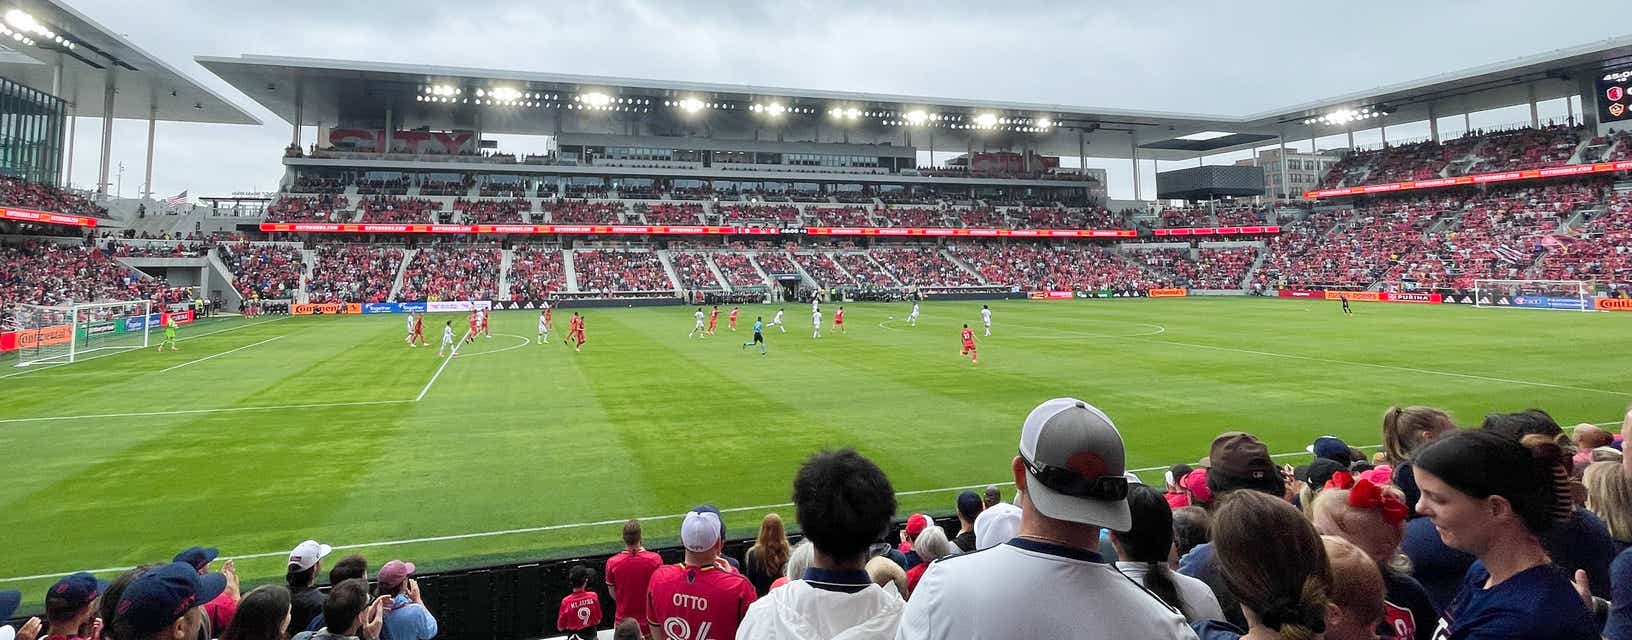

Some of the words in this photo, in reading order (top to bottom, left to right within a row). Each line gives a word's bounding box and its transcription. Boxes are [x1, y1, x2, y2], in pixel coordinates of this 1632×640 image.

[329, 128, 474, 154] CITY
[673, 593, 708, 611] OTTO
[577, 606, 591, 625] 9
